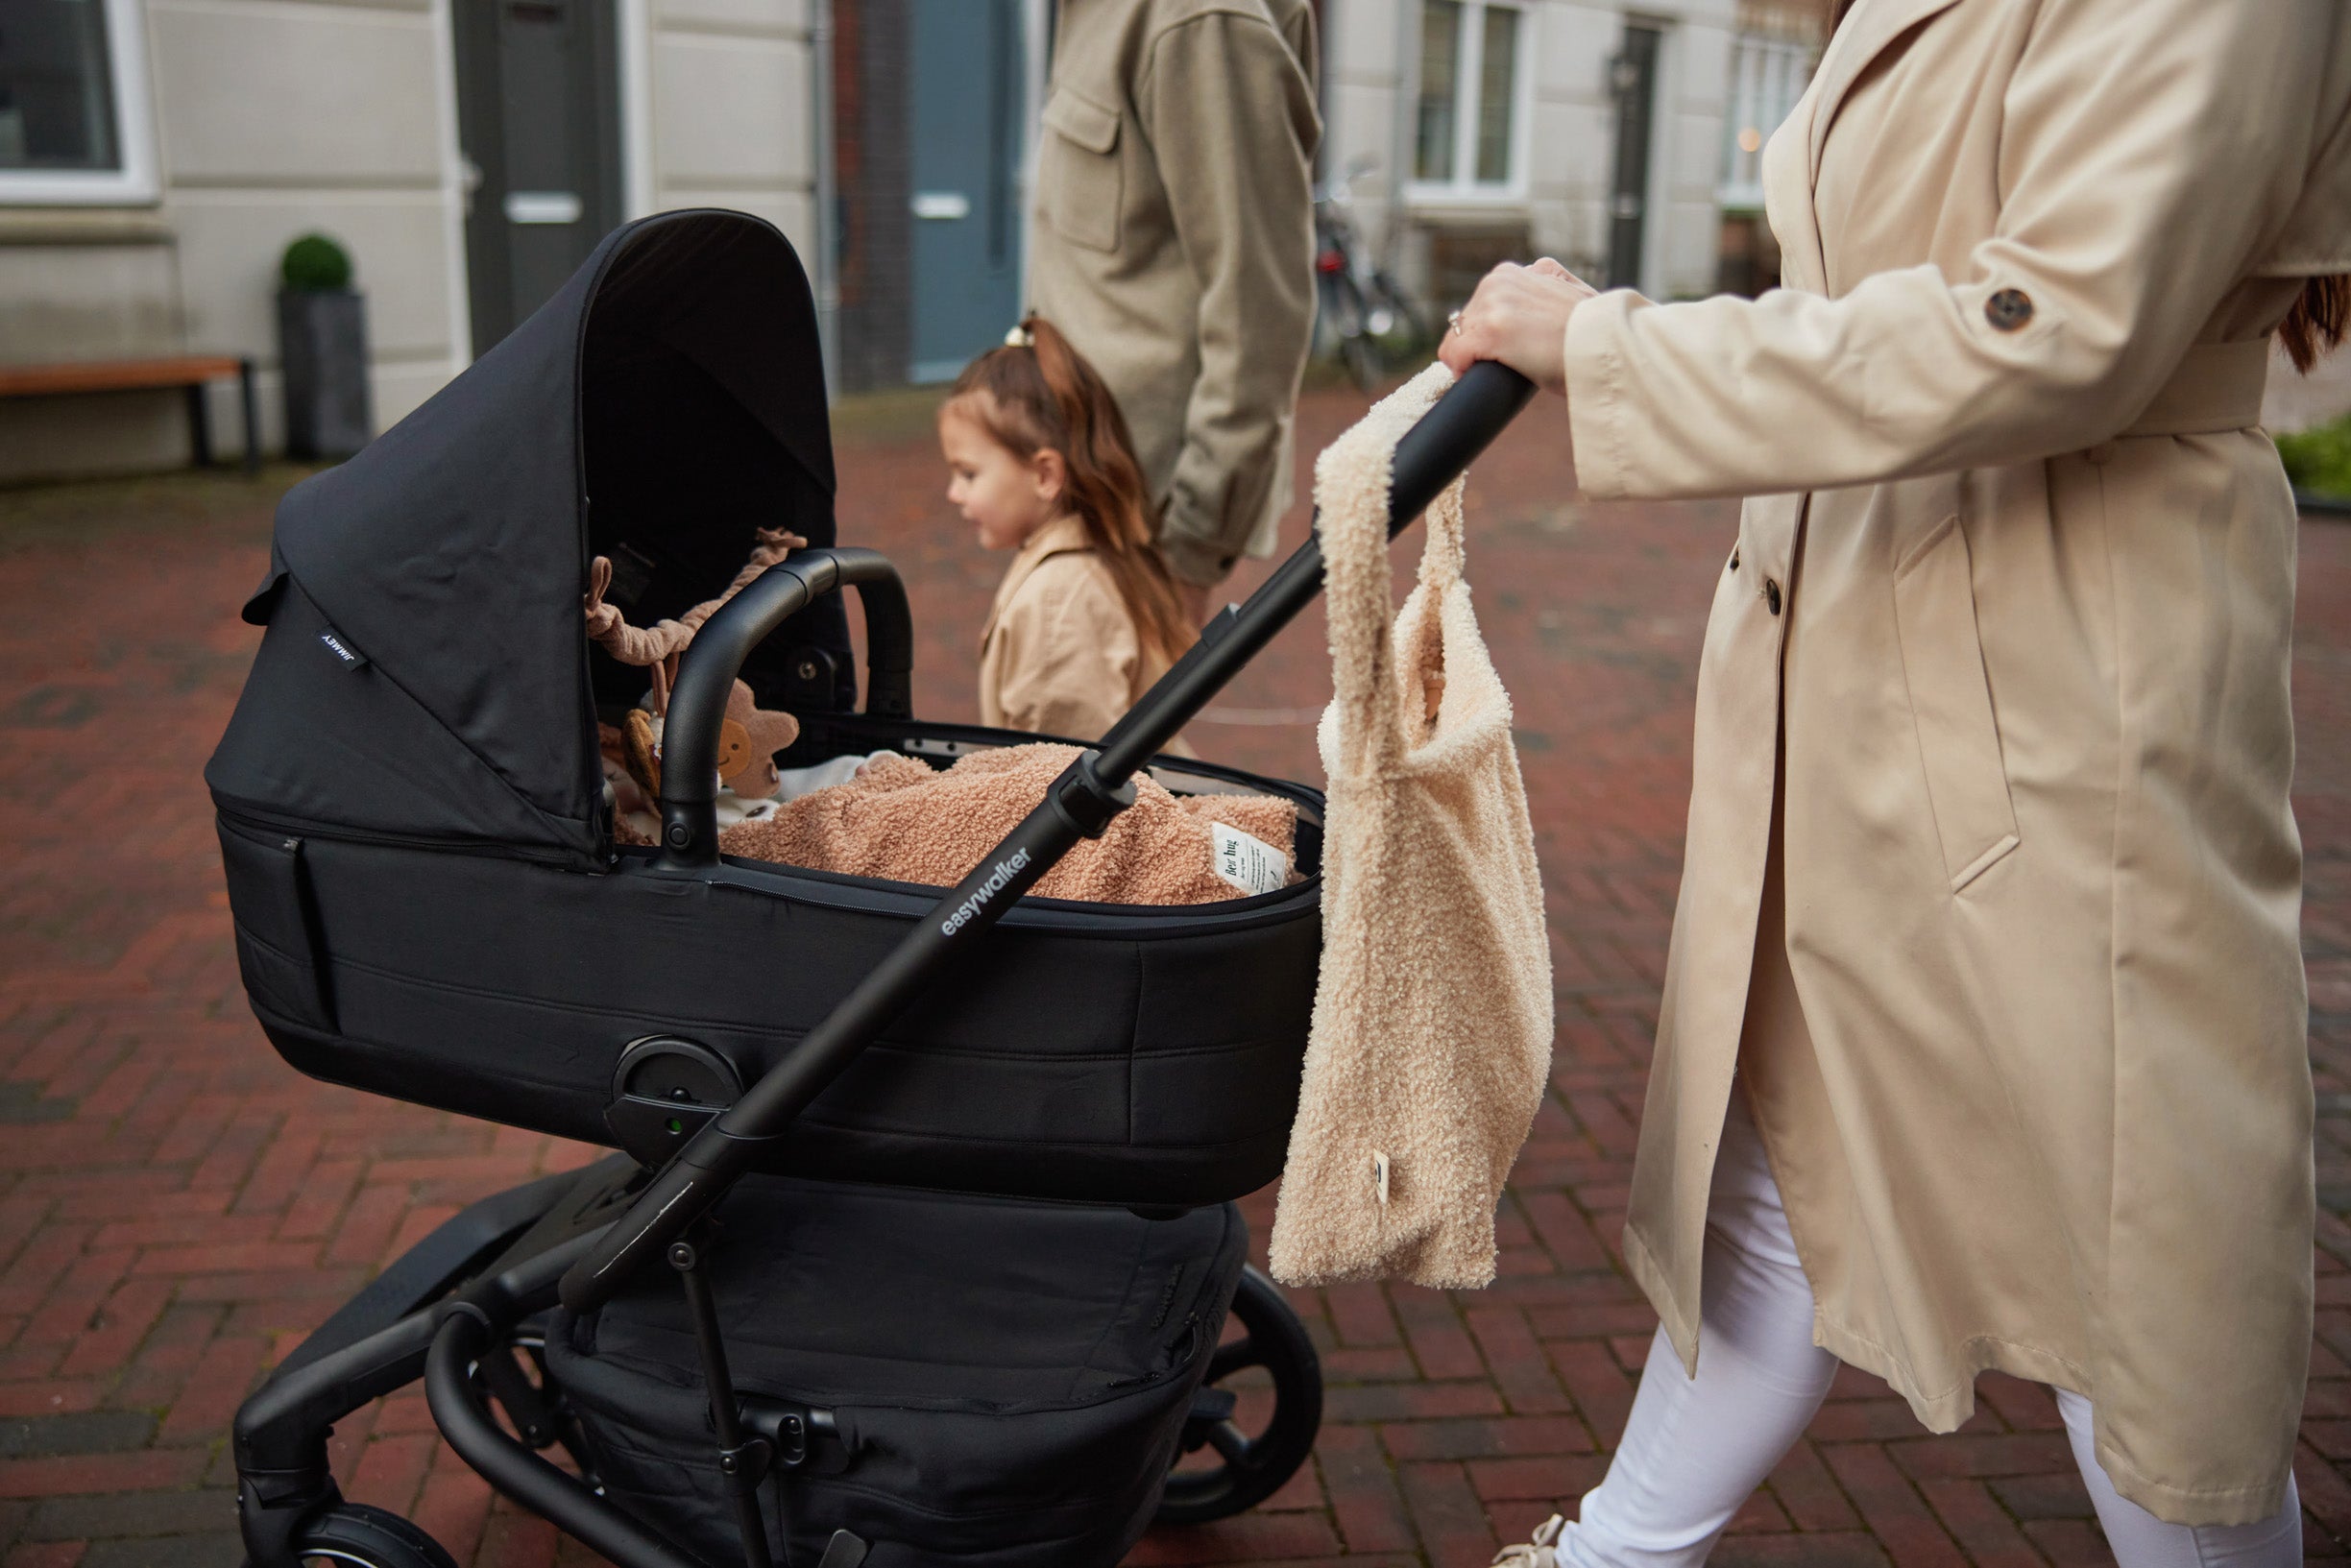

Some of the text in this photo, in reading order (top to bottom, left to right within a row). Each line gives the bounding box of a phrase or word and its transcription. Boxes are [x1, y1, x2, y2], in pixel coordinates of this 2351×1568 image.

[322, 635, 354, 661] JIMMEY
[1223, 839, 1240, 856] hug
[941, 847, 1031, 936] easywalker
